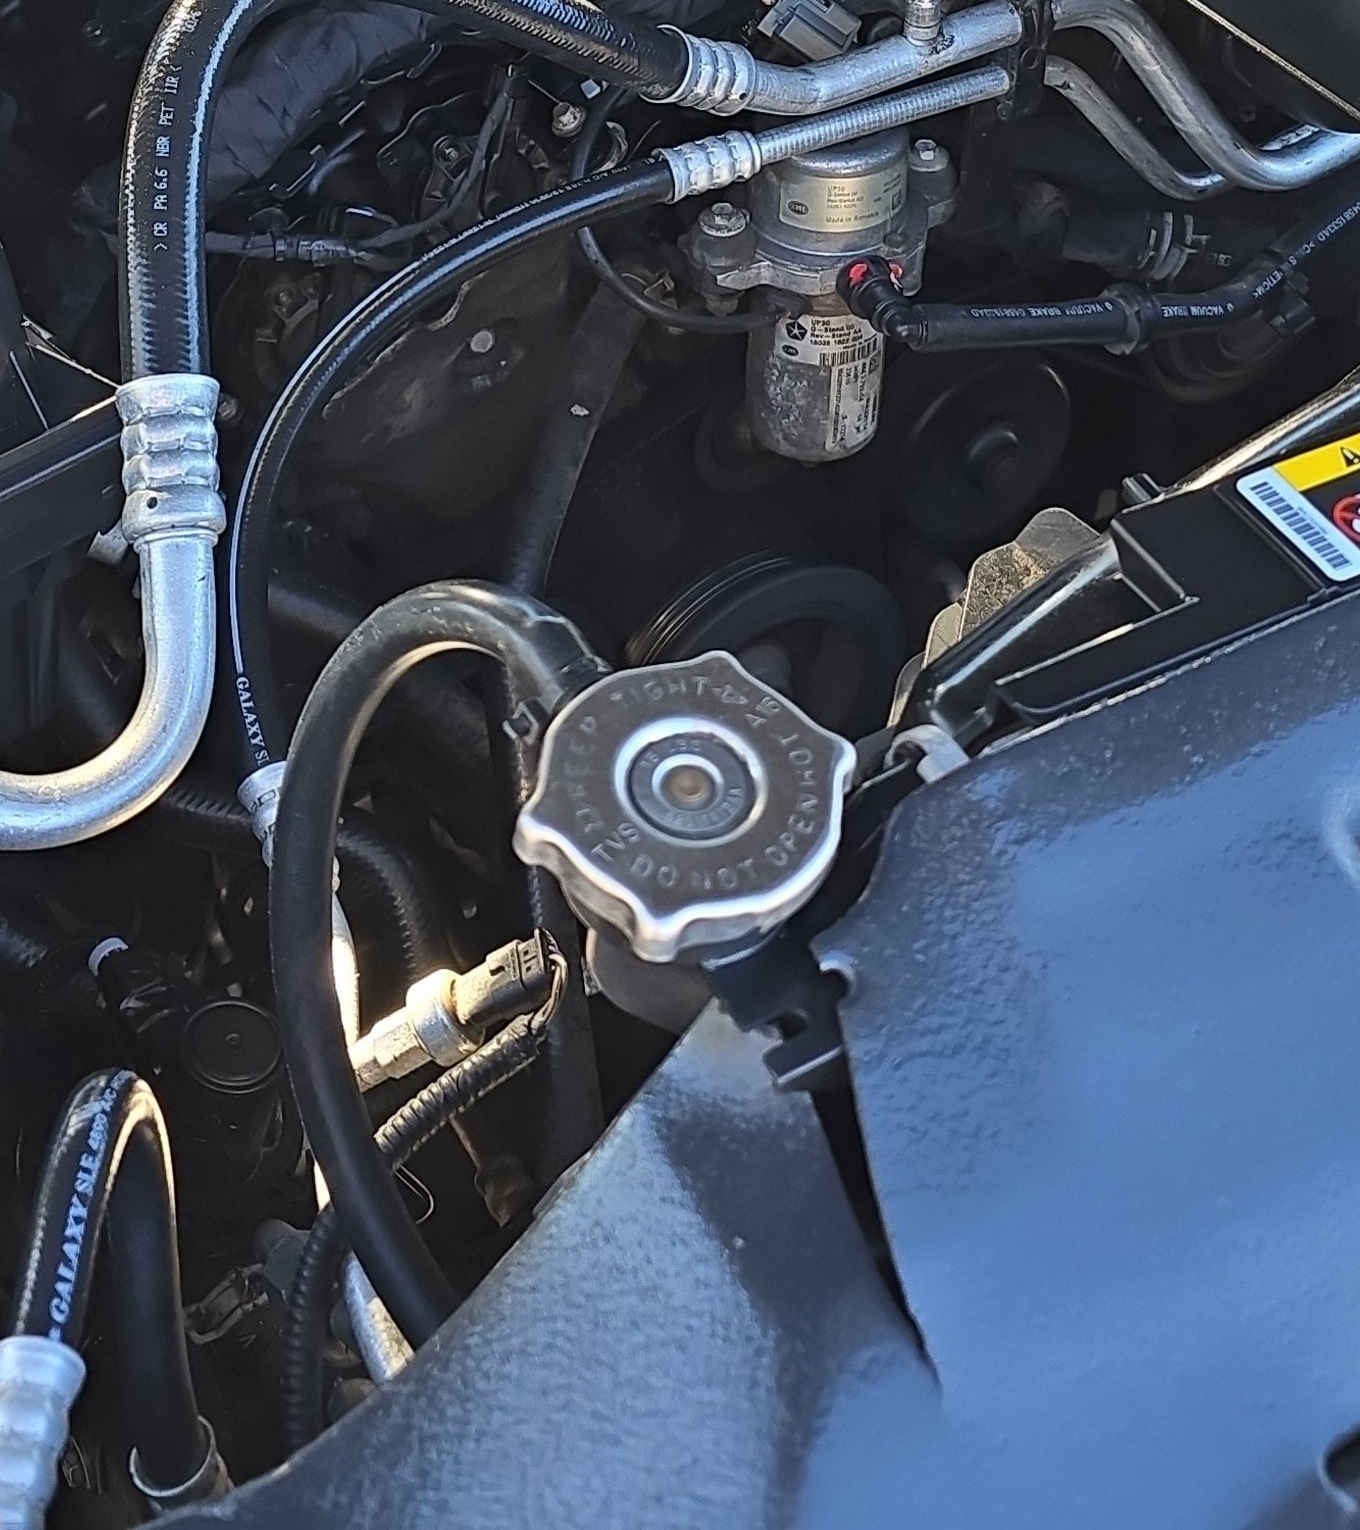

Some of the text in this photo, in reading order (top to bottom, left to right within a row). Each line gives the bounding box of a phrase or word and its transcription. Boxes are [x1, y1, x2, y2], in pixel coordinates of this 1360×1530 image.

[155, 135, 171, 157] NBR
[158, 102, 175, 126] PET
[236, 676, 266, 748] GALAXY
[630, 853, 678, 888] DO
[764, 792, 819, 867] OPEN
[48, 1193, 89, 1325] GALAXY
[74, 1151, 100, 1198] SLE
